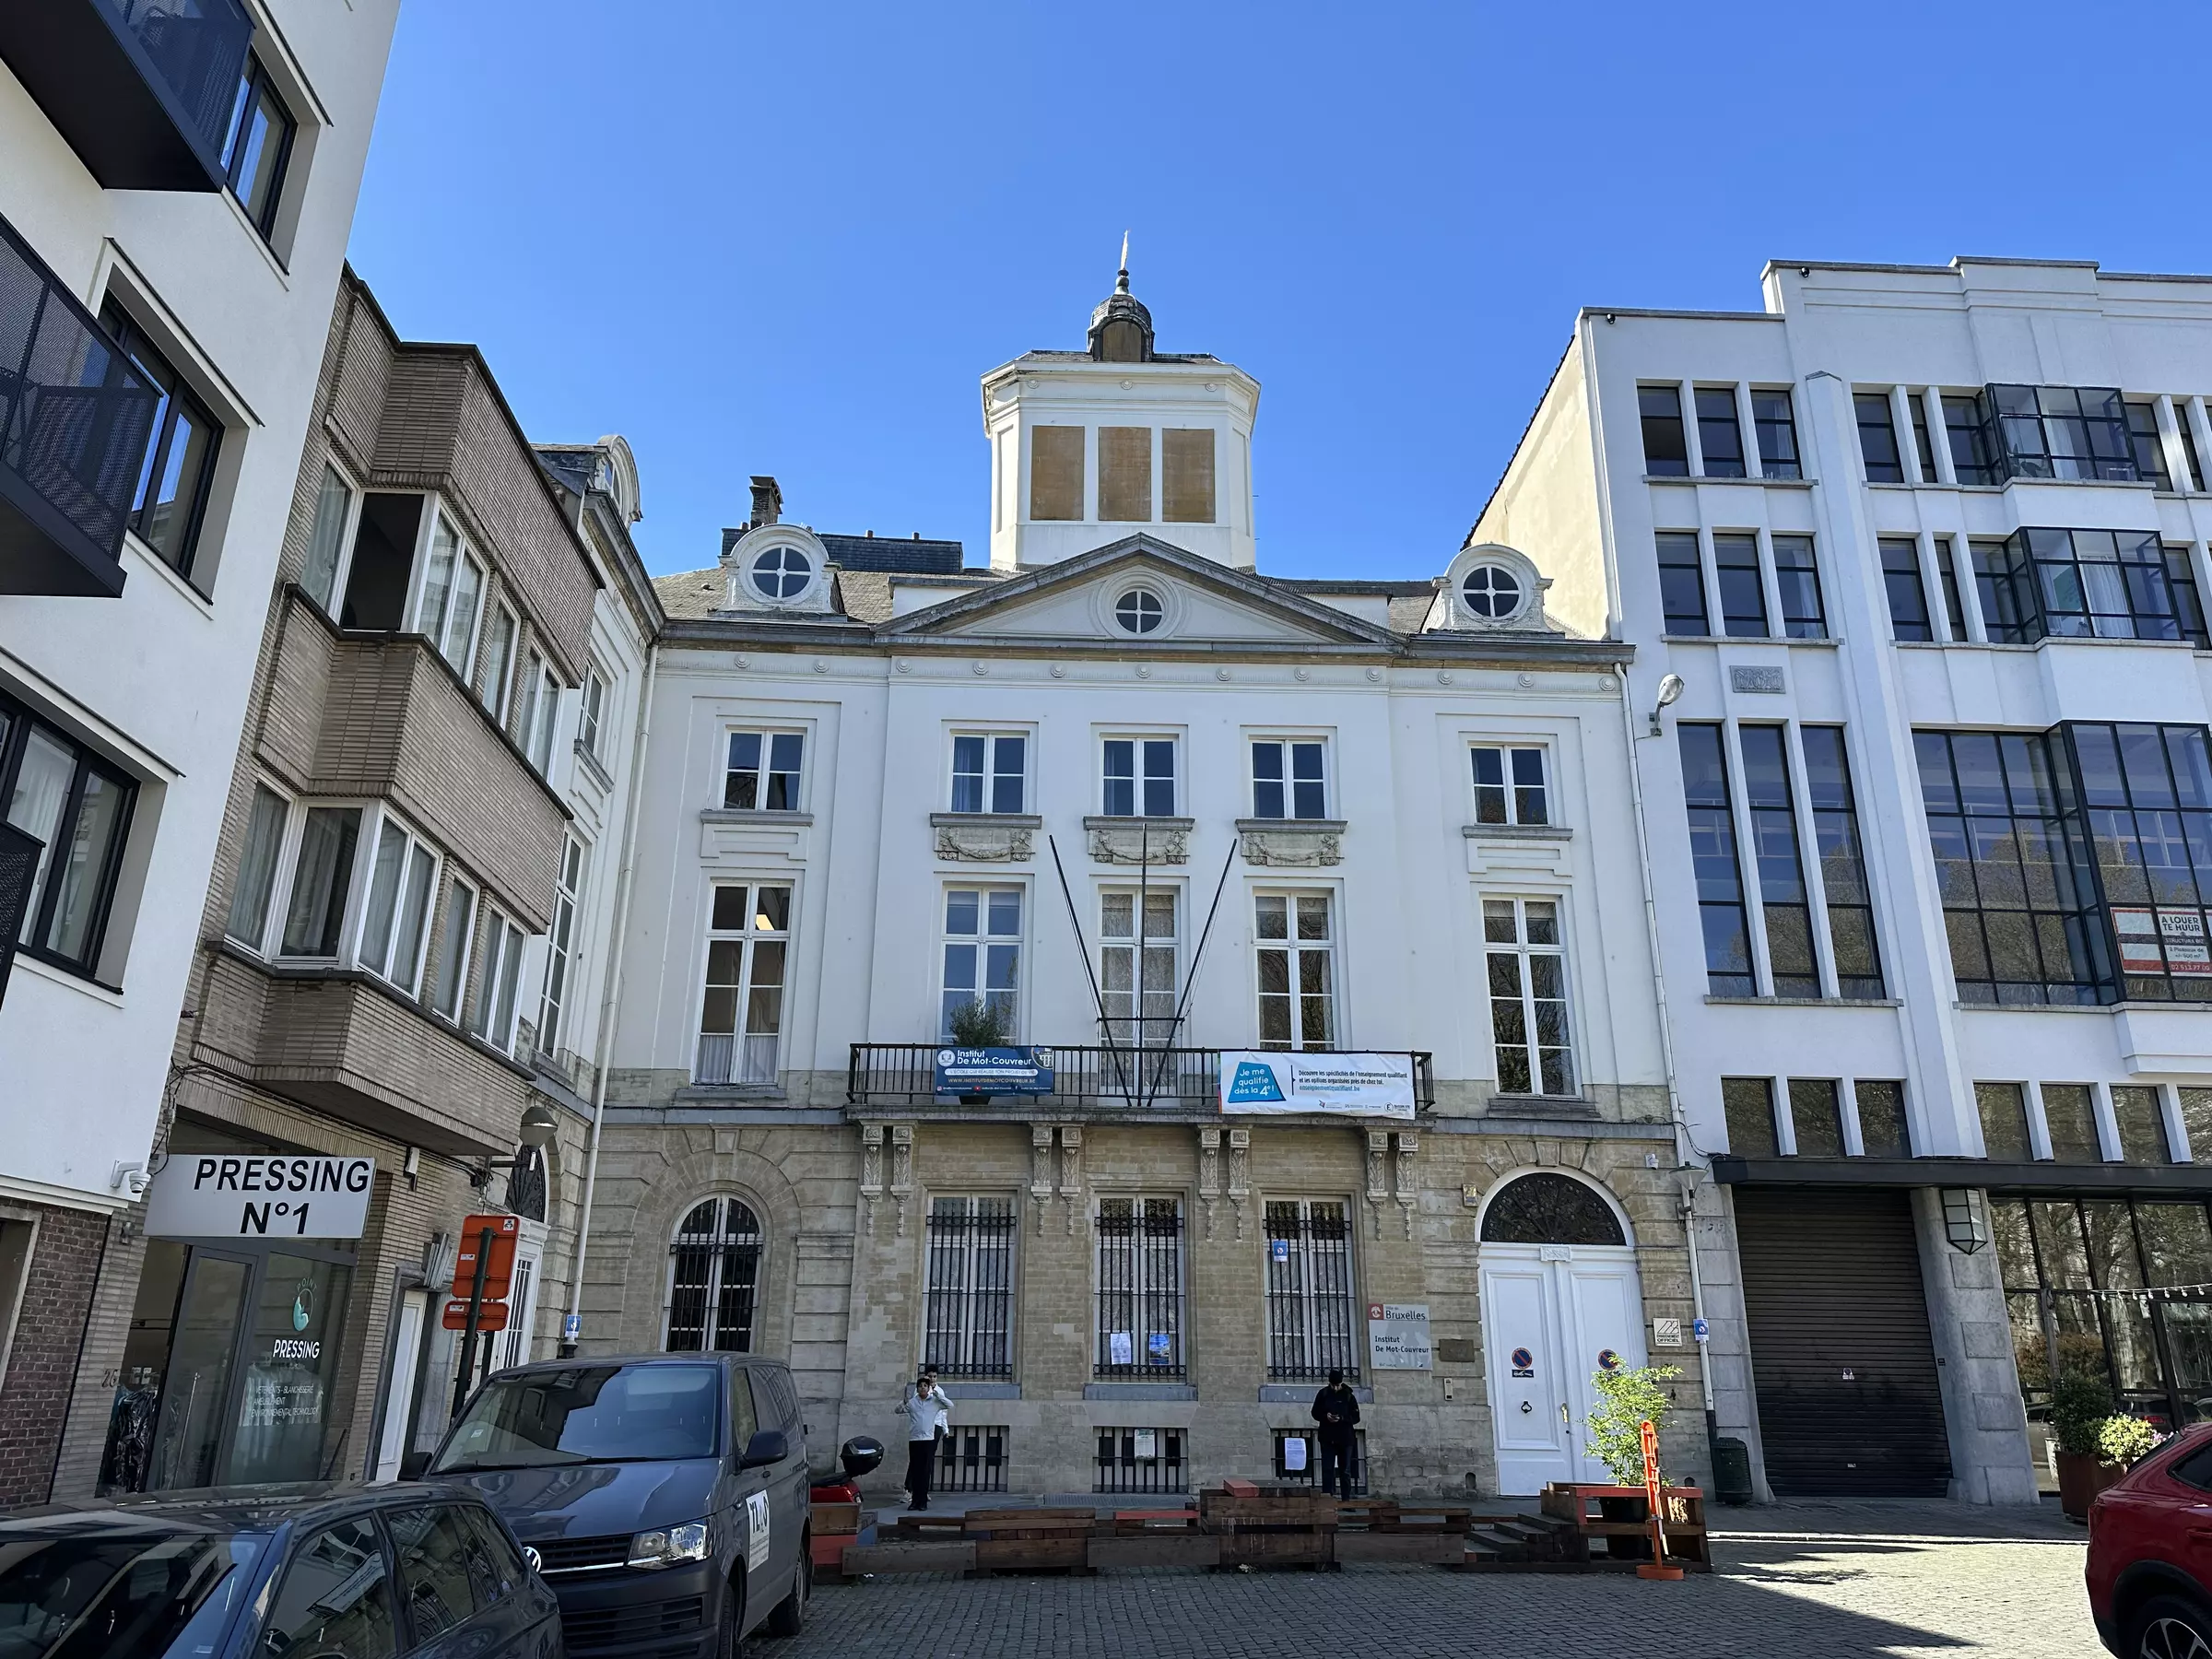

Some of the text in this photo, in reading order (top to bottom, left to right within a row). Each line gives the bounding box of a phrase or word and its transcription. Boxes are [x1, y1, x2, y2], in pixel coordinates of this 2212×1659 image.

[2170, 916, 2199, 924] LOUER
[2175, 924, 2201, 932] HUUR
[957, 1049, 986, 1058] Institut
[971, 1056, 1032, 1065] Mot-Couvreur
[1238, 1077, 1269, 1087] qualifie
[1234, 1087, 1250, 1095] dès
[194, 1158, 370, 1193] PRESSING
[240, 1202, 310, 1235] N°1
[296, 1277, 318, 1292] POINT
[1385, 1310, 1426, 1320] Bruxelles
[273, 1339, 321, 1359] PRESSING
